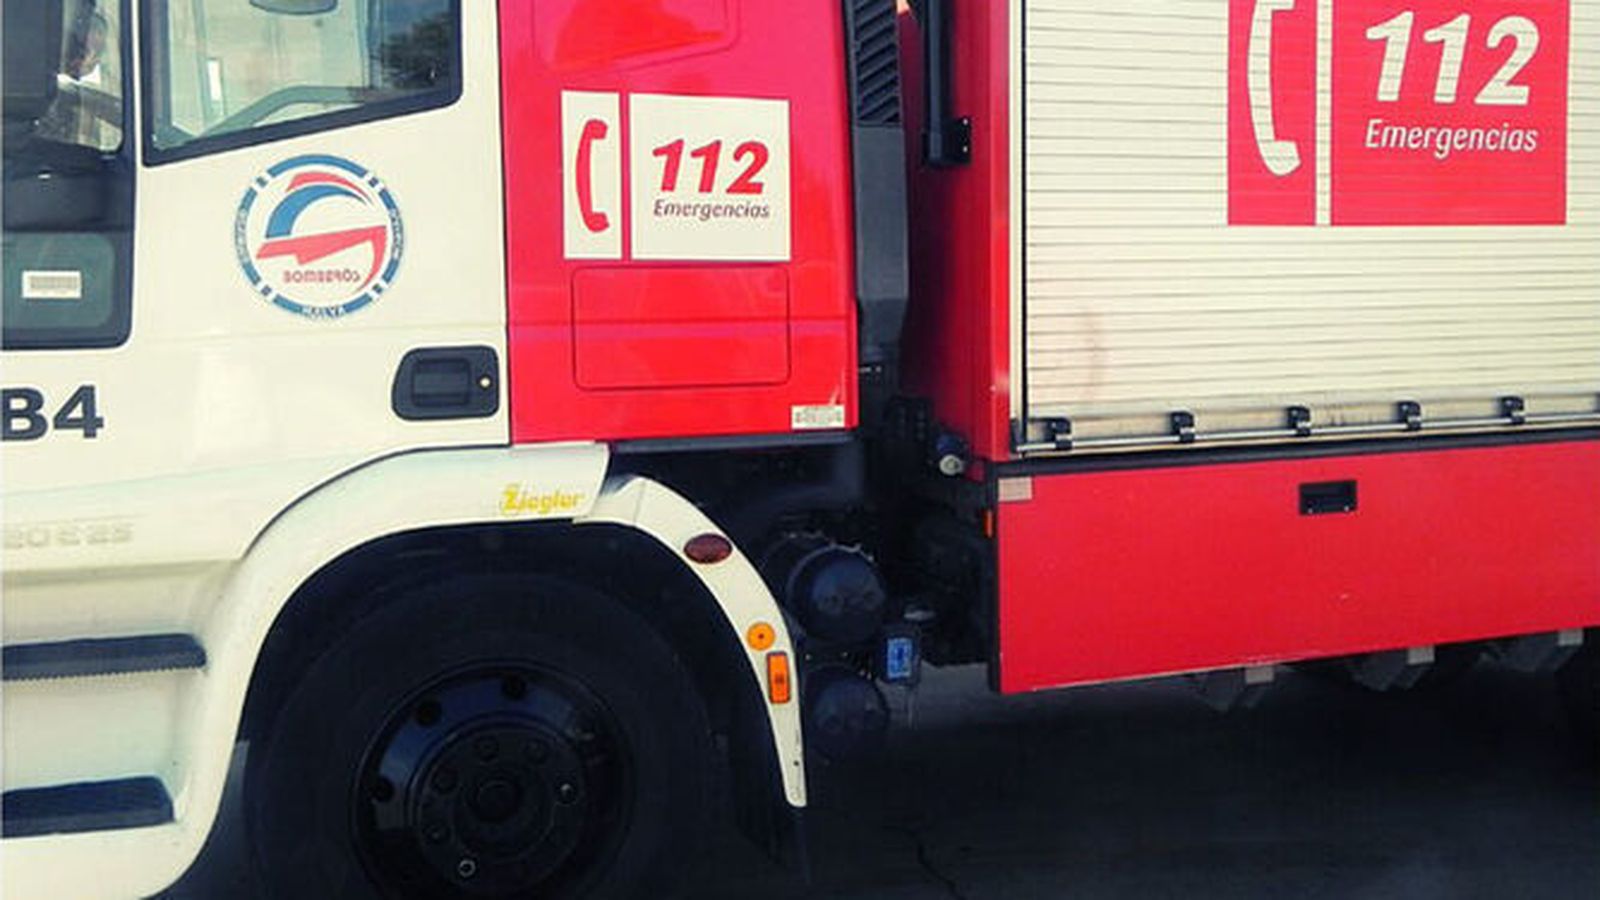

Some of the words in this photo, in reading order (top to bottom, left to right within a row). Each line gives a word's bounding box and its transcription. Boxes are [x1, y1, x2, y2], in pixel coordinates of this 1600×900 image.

[1366, 11, 1541, 105] 112
[652, 138, 769, 195] 112
[1365, 118, 1539, 160] Emergencias
[653, 199, 771, 222] Emergencias
[1, 384, 104, 442] B4
